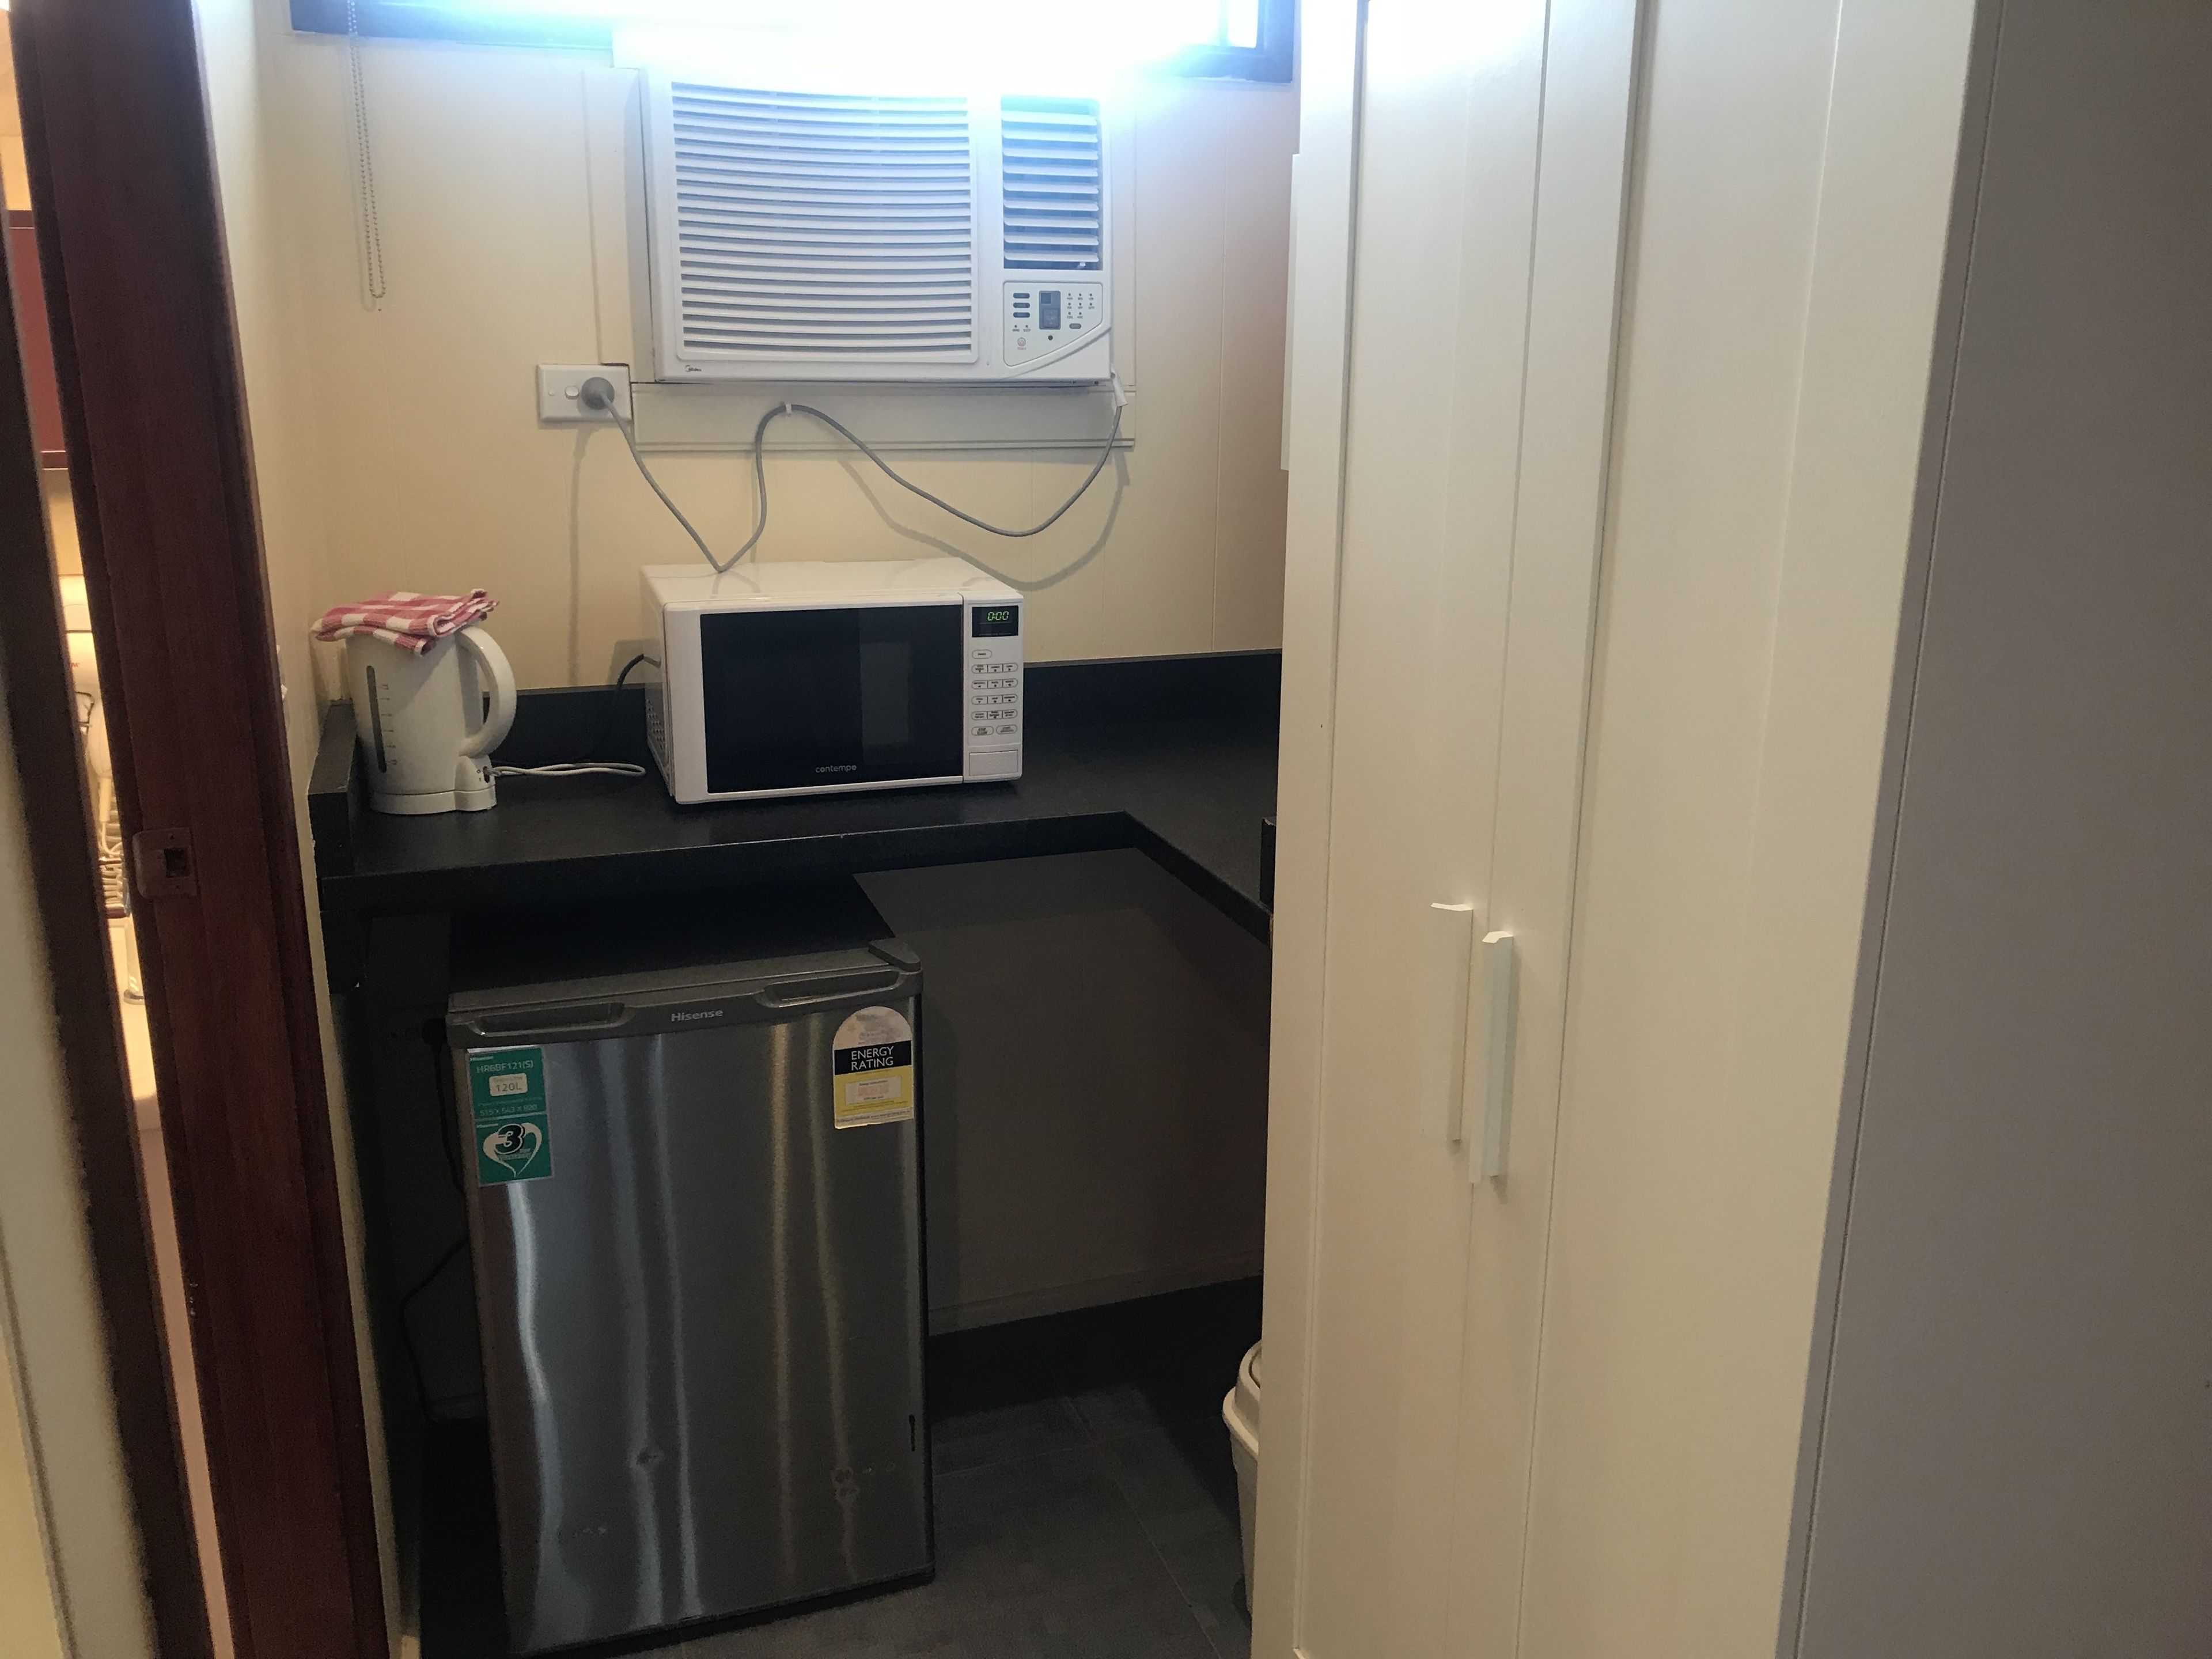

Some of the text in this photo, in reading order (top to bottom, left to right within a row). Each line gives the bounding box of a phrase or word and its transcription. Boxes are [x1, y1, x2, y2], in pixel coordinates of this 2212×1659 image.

[987, 611, 1009, 621] 0:00
[815, 764, 857, 773] contempo
[671, 1009, 724, 1022] Hisense
[851, 1046, 894, 1060] ENERGY
[851, 1056, 893, 1071] RATING
[495, 1082, 522, 1092] 120L
[494, 1123, 527, 1154] 3
